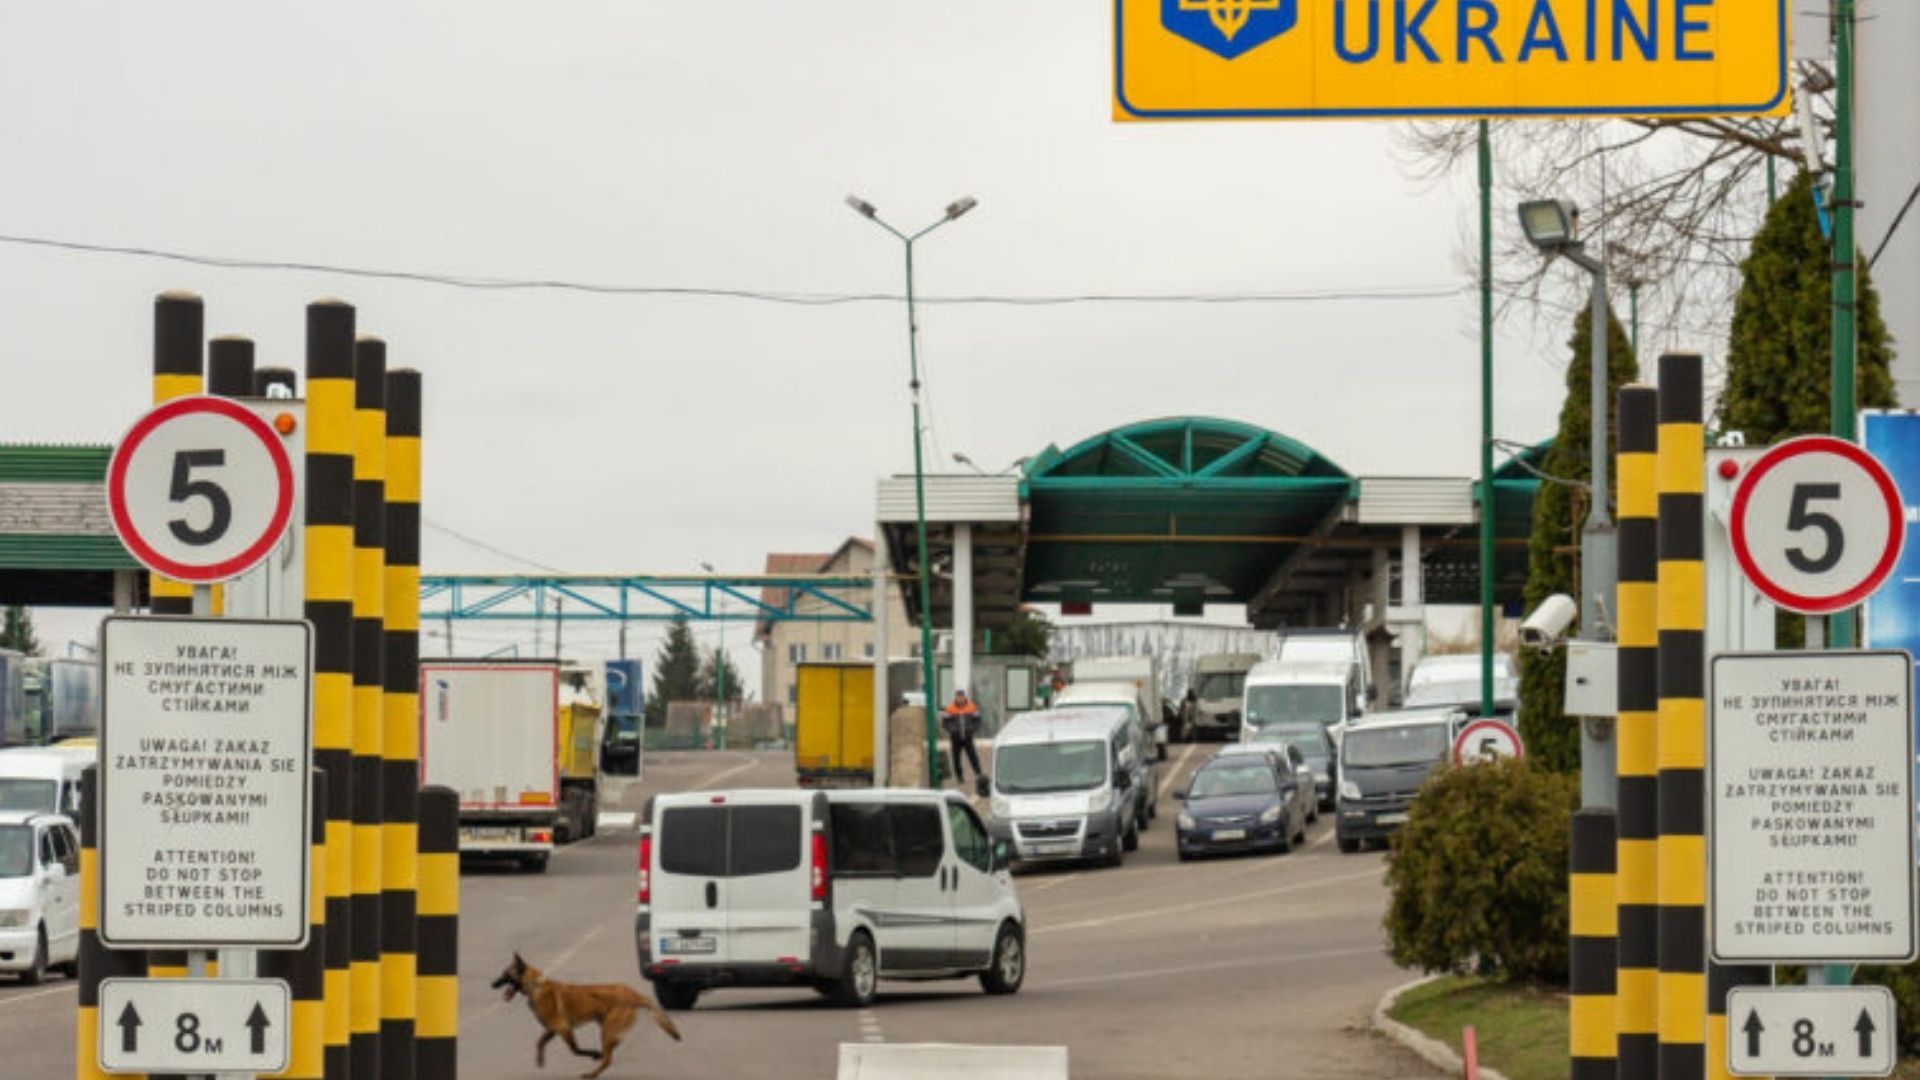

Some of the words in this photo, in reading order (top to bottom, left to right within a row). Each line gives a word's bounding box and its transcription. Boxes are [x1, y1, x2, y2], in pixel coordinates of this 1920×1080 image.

[1333, 0, 1714, 63] UKRAINE
[167, 449, 232, 546] 5
[1784, 482, 1845, 574] 5
[176, 645, 237, 660] УВАГА!
[114, 661, 135, 676] НЕ
[144, 661, 256, 679] ЗУПИНЯТИСЯ
[261, 665, 298, 679] МІЖ
[147, 680, 265, 696] СМУГАСТИМИ
[1781, 678, 1840, 692] УВАГА!
[1722, 695, 1743, 710] НЕ
[1865, 694, 1899, 707] МІЖ
[1755, 712, 1868, 727] СМУГАСТИМИ
[139, 738, 207, 753] UWAGA!
[214, 739, 270, 755] ZAKAZ
[115, 755, 263, 772] ZATRZYMYWANIA
[1748, 767, 1814, 781] UWAGA!
[1821, 766, 1875, 780] ZAKAZ
[1725, 783, 1868, 798] ZATRZYMYWANIA
[1751, 816, 1875, 831] PASKOWANYMI
[153, 849, 256, 865] ATTENTION!
[146, 866, 170, 882] DO
[176, 867, 211, 882] NOT
[218, 867, 263, 883] STOP
[1763, 870, 1865, 885] ATTENTION!
[143, 884, 225, 900] BETWEEN
[232, 885, 265, 901] THE
[1755, 887, 1779, 903] DO
[1786, 887, 1819, 902] NOT
[1827, 887, 1872, 902] STOP
[123, 902, 197, 918] STRIPED
[202, 902, 285, 919] COLUMNS
[1753, 904, 1834, 919] BETWEEN
[1841, 903, 1873, 918] THE
[1733, 921, 1805, 936] STRIPED
[1812, 920, 1894, 936] COLUMNS
